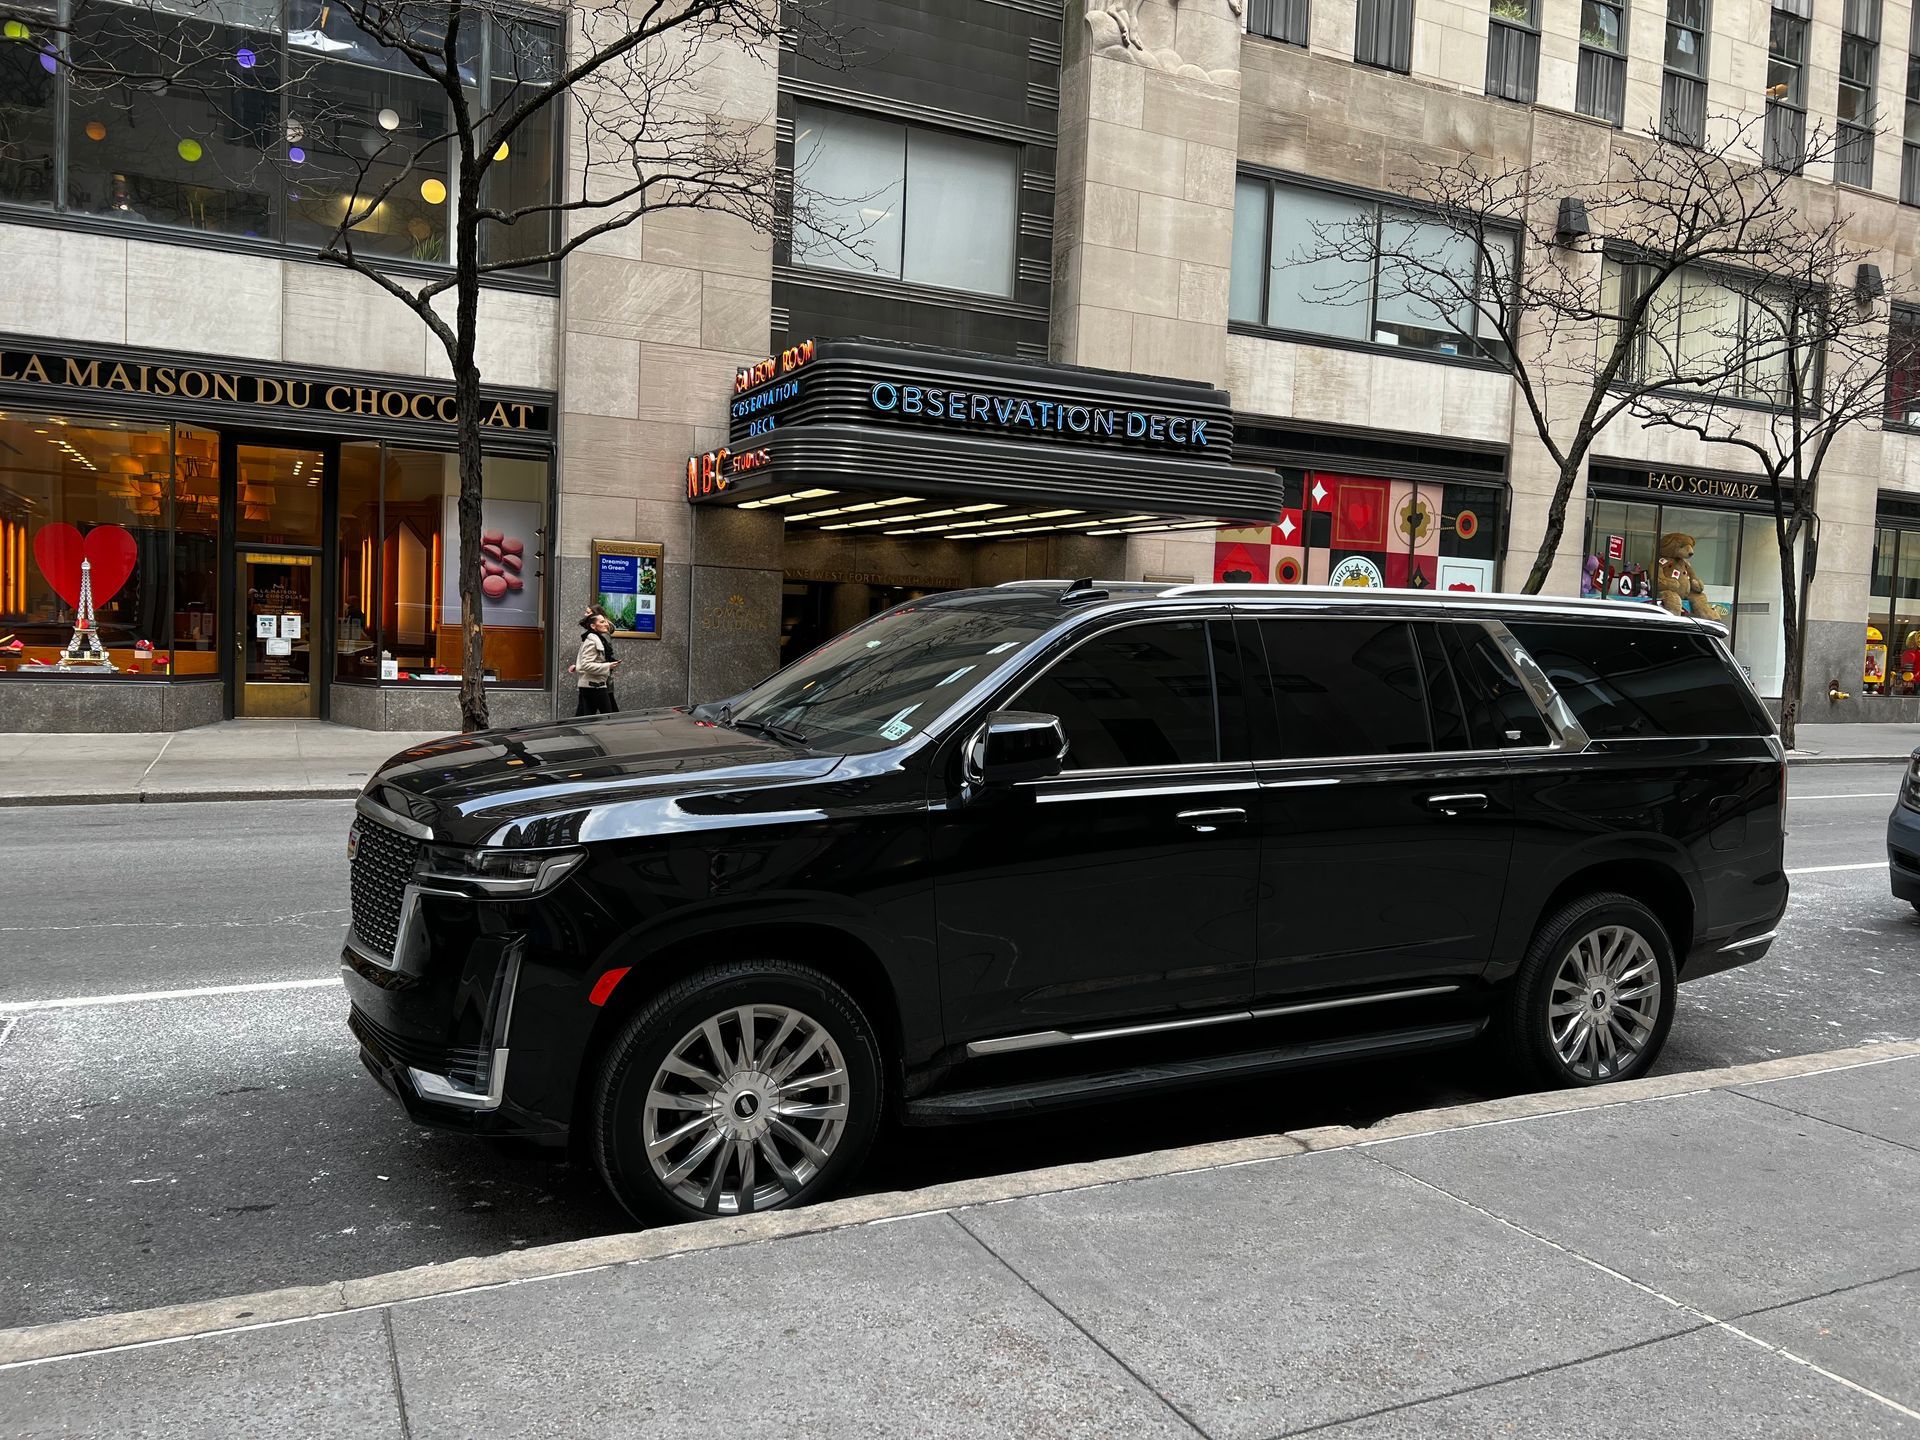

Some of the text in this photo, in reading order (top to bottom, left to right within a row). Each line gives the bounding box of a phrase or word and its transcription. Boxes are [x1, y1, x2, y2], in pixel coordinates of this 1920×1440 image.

[782, 339, 814, 371] ROOM
[0, 351, 534, 429] LA MAISON DU CHOCOAT
[732, 380, 799, 418] OBSERVATION
[750, 415, 776, 437] DECK
[872, 382, 1208, 446] OBSERVATION DECK
[688, 447, 730, 498] NBC
[1688, 477, 1760, 500] SCHWARZ
[602, 558, 630, 566] Dreaming
[785, 569, 809, 580] NINE
[815, 571, 843, 582] WEST
[849, 573, 881, 584] FORTY
